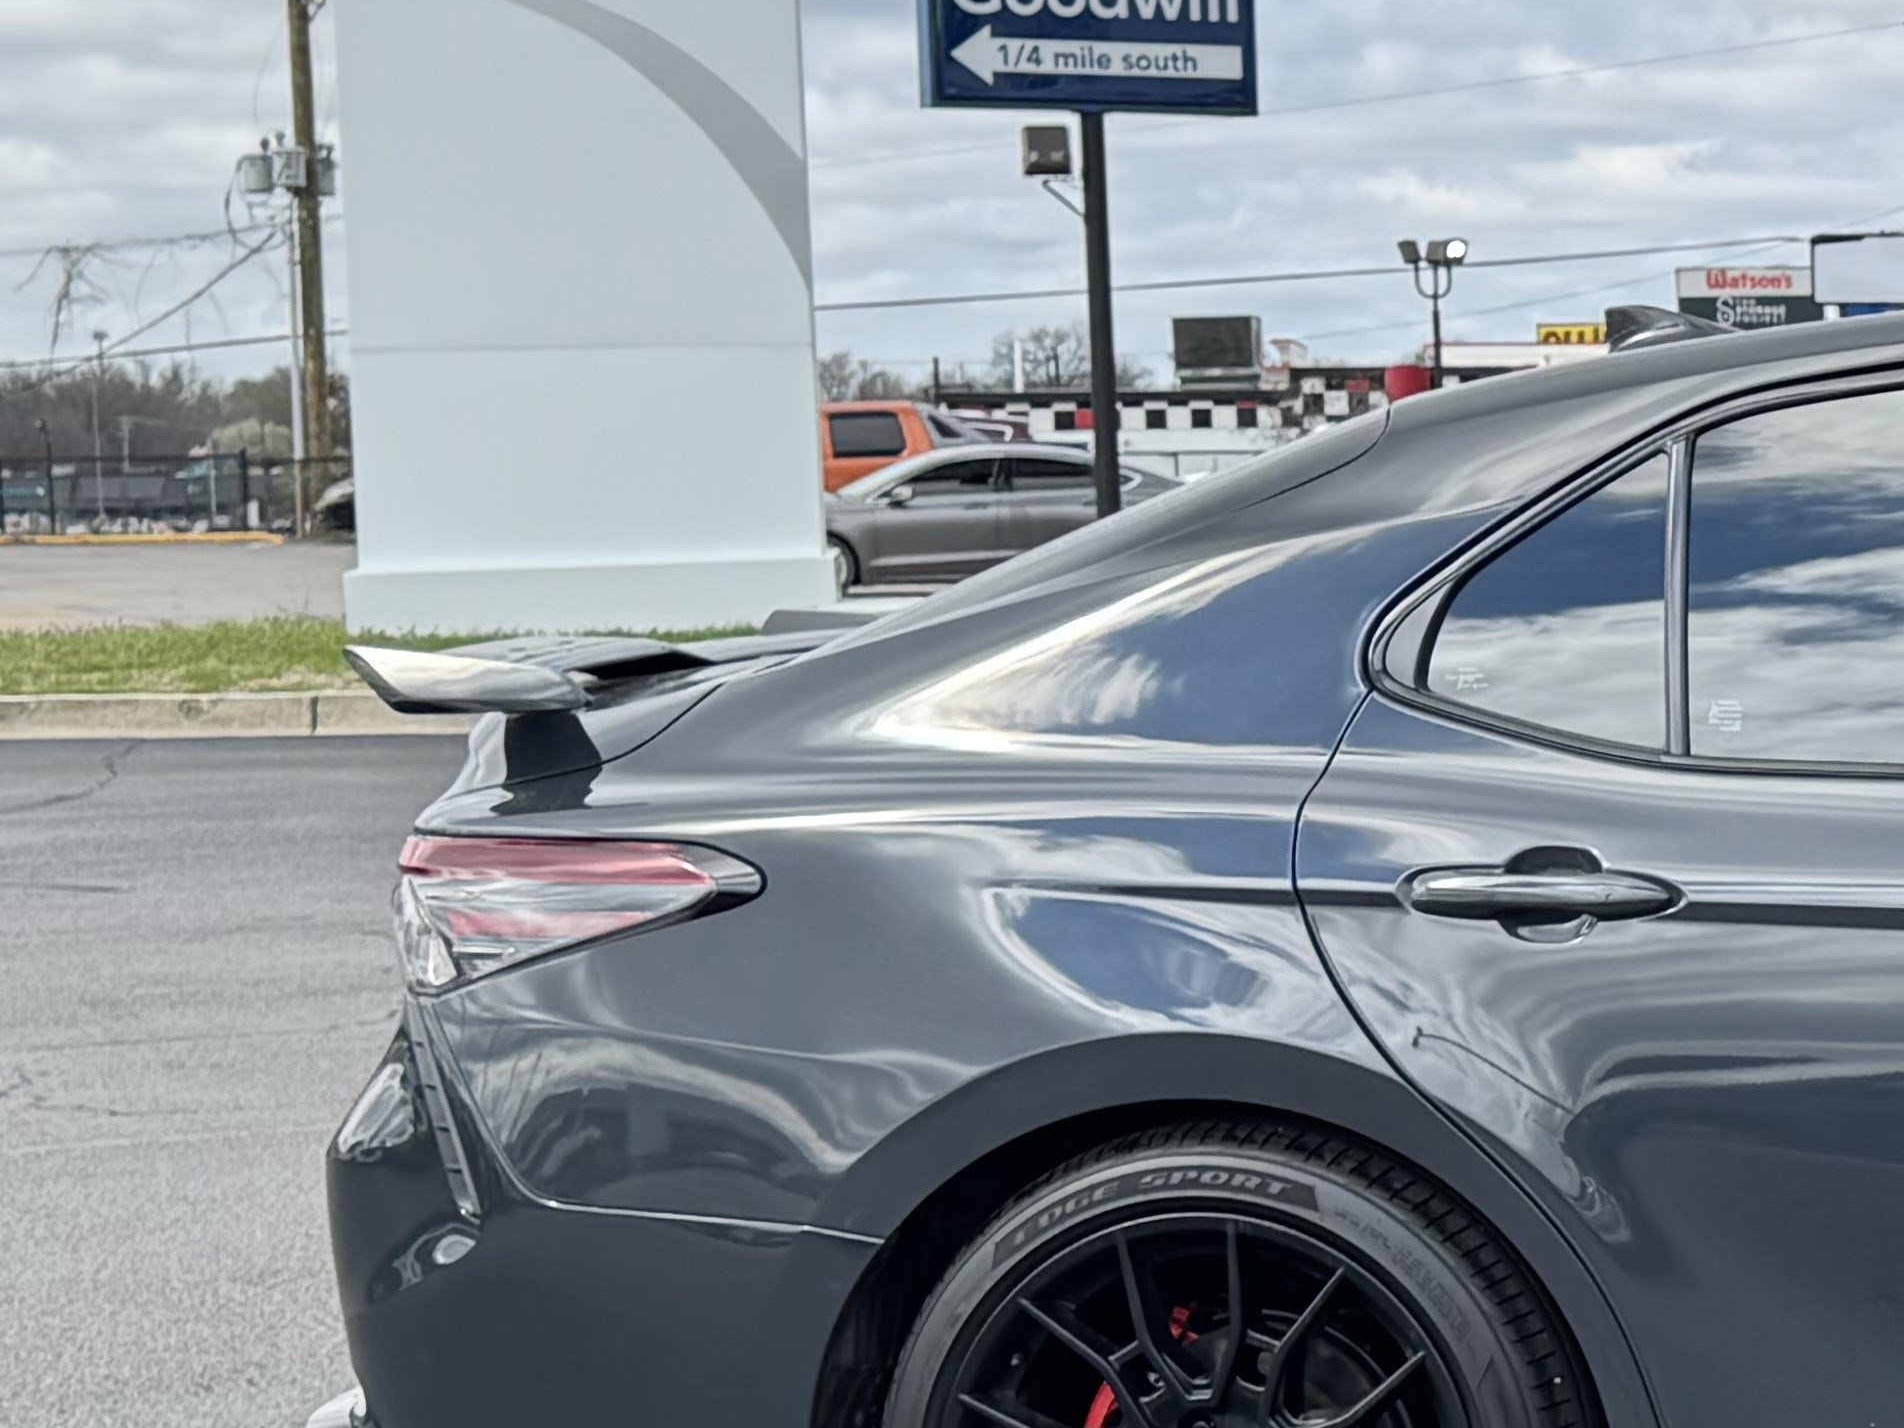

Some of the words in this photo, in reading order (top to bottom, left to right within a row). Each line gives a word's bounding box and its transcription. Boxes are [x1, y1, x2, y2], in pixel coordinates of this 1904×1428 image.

[997, 44, 1043, 68] 1/4
[1053, 47, 1112, 70] mile
[1121, 50, 1198, 73] south
[1706, 268, 1792, 289] Watson's
[1140, 1170, 1292, 1194] SPORT
